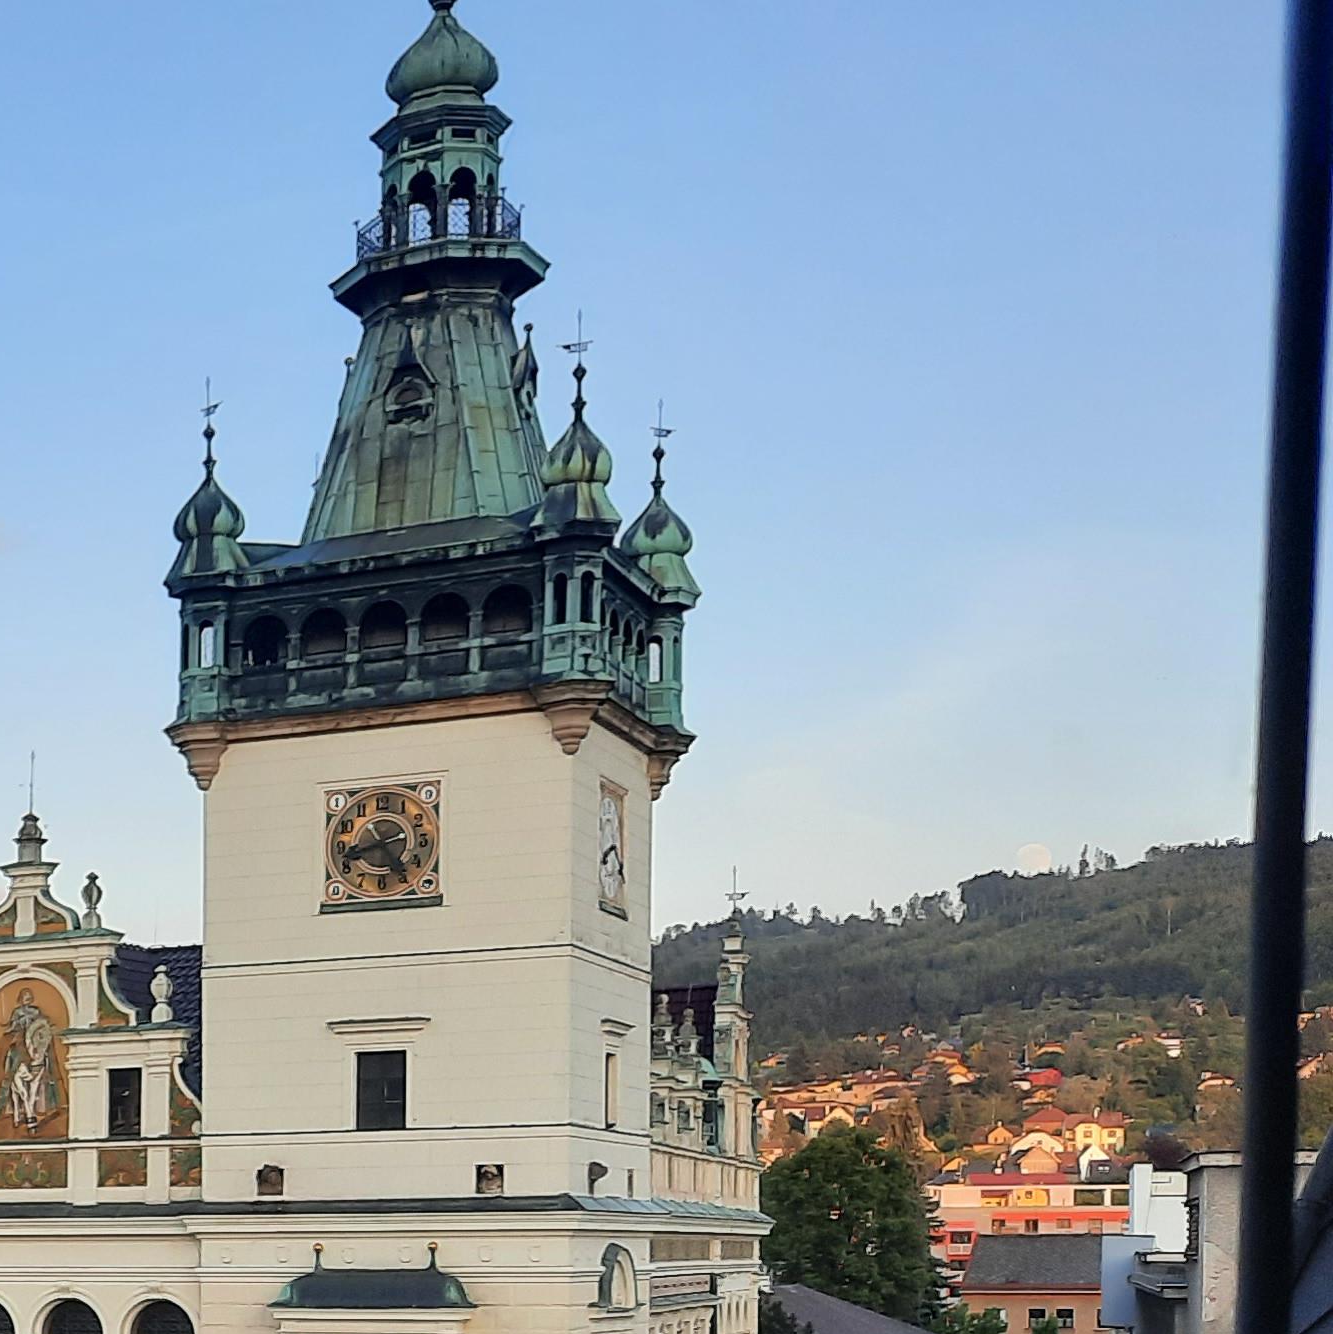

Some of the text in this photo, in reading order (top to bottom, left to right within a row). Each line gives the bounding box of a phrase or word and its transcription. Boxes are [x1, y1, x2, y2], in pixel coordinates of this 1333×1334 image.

[357, 803, 366, 817] 11
[376, 796, 389, 811] 12
[400, 799, 406, 814] 1
[341, 819, 353, 834] 10
[414, 813, 423, 828] 2
[336, 841, 345, 855] 9
[419, 833, 428, 848] 3
[342, 859, 351, 874] 8
[411, 854, 421, 868] 4
[357, 873, 366, 888] 7
[378, 873, 387, 890] 6
